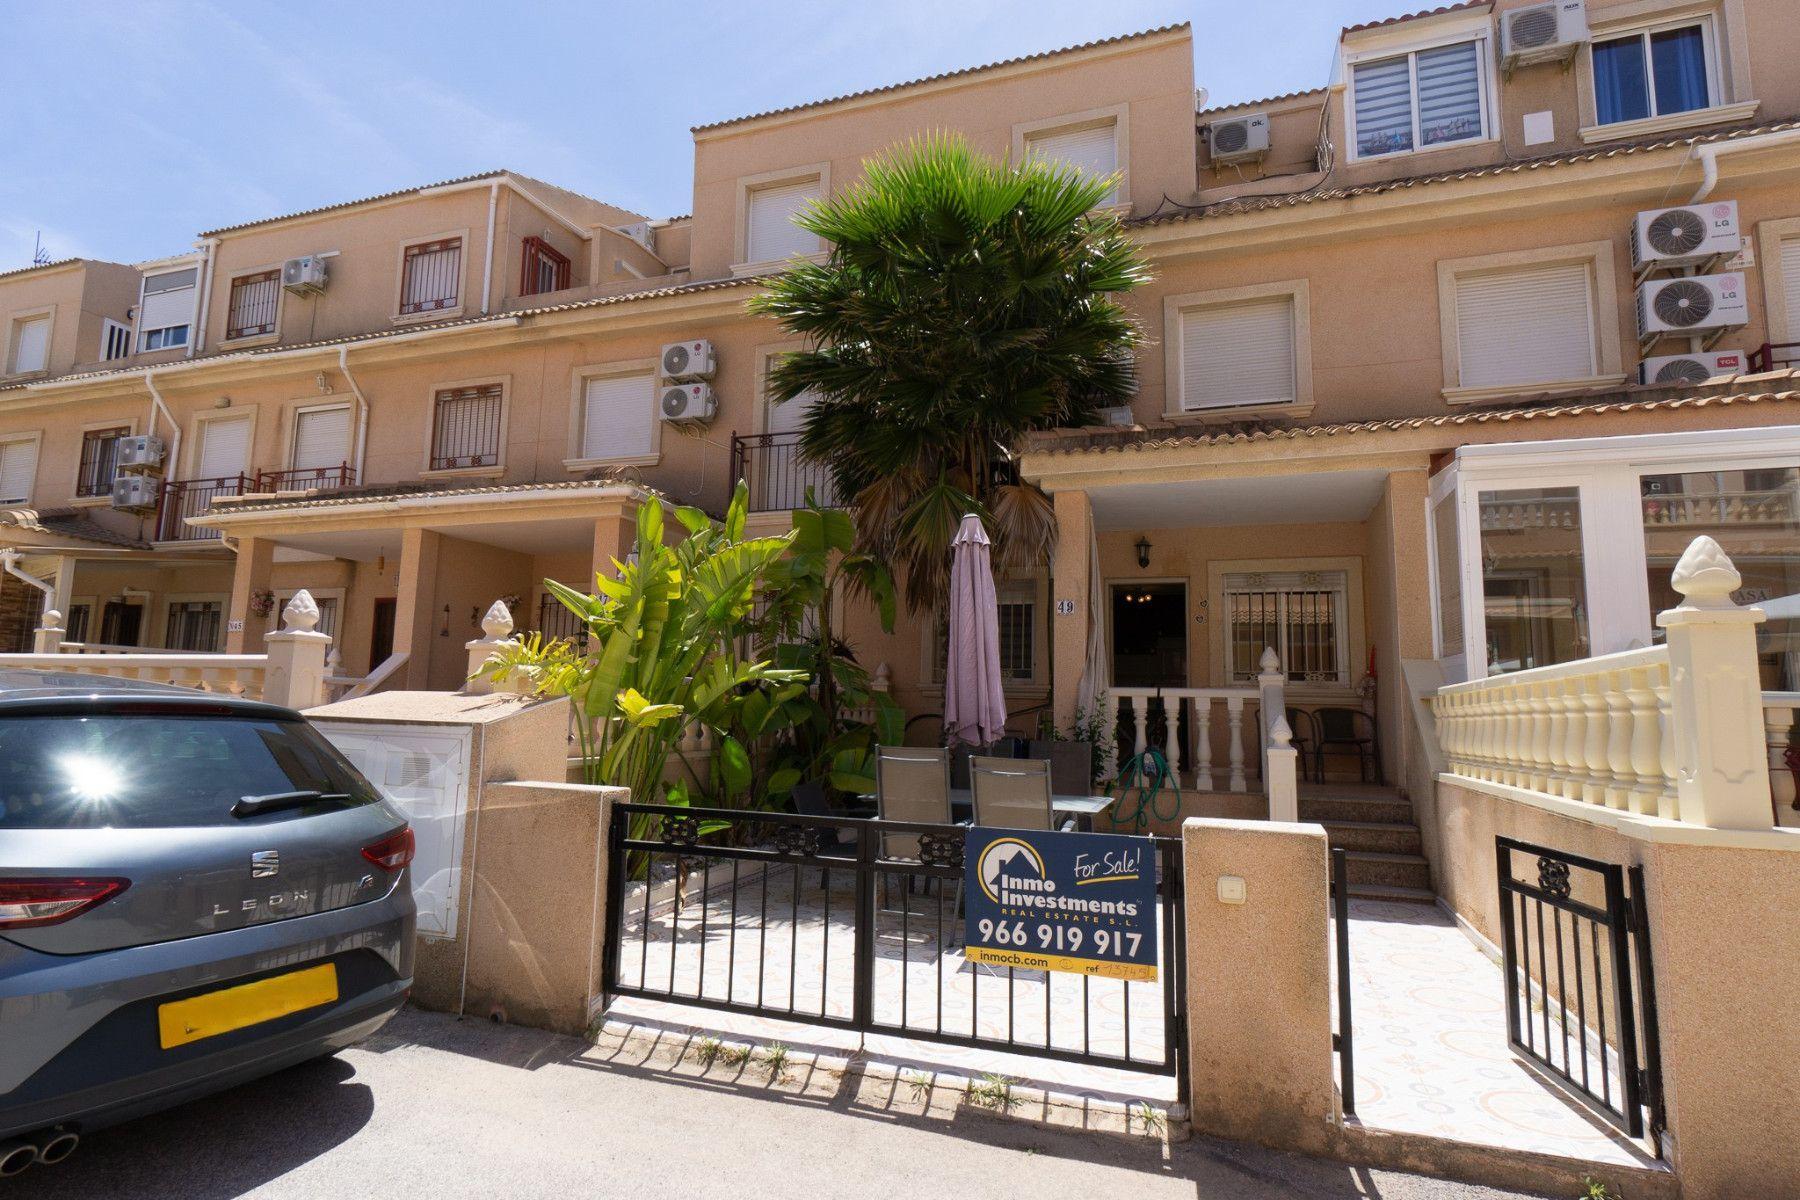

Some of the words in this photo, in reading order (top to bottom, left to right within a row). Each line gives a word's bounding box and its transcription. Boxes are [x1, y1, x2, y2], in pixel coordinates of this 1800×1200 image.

[1715, 219, 1730, 228] LG
[1722, 291, 1737, 299] LG
[1058, 601, 1074, 613] 49
[1074, 854, 1099, 878] For
[1103, 848, 1141, 875] Sale!
[1001, 874, 1056, 892] Inmo
[213, 890, 308, 915] LEON
[1001, 890, 1138, 916] Investments
[1002, 908, 1035, 918] REAL
[1045, 912, 1099, 923] ESTATE
[1109, 918, 1139, 927] S.L.
[978, 918, 1028, 946] 966
[1037, 924, 1083, 952] 919
[1093, 929, 1142, 957] 917
[979, 950, 1049, 968] inmocb.com
[1086, 965, 1099, 973] ref
